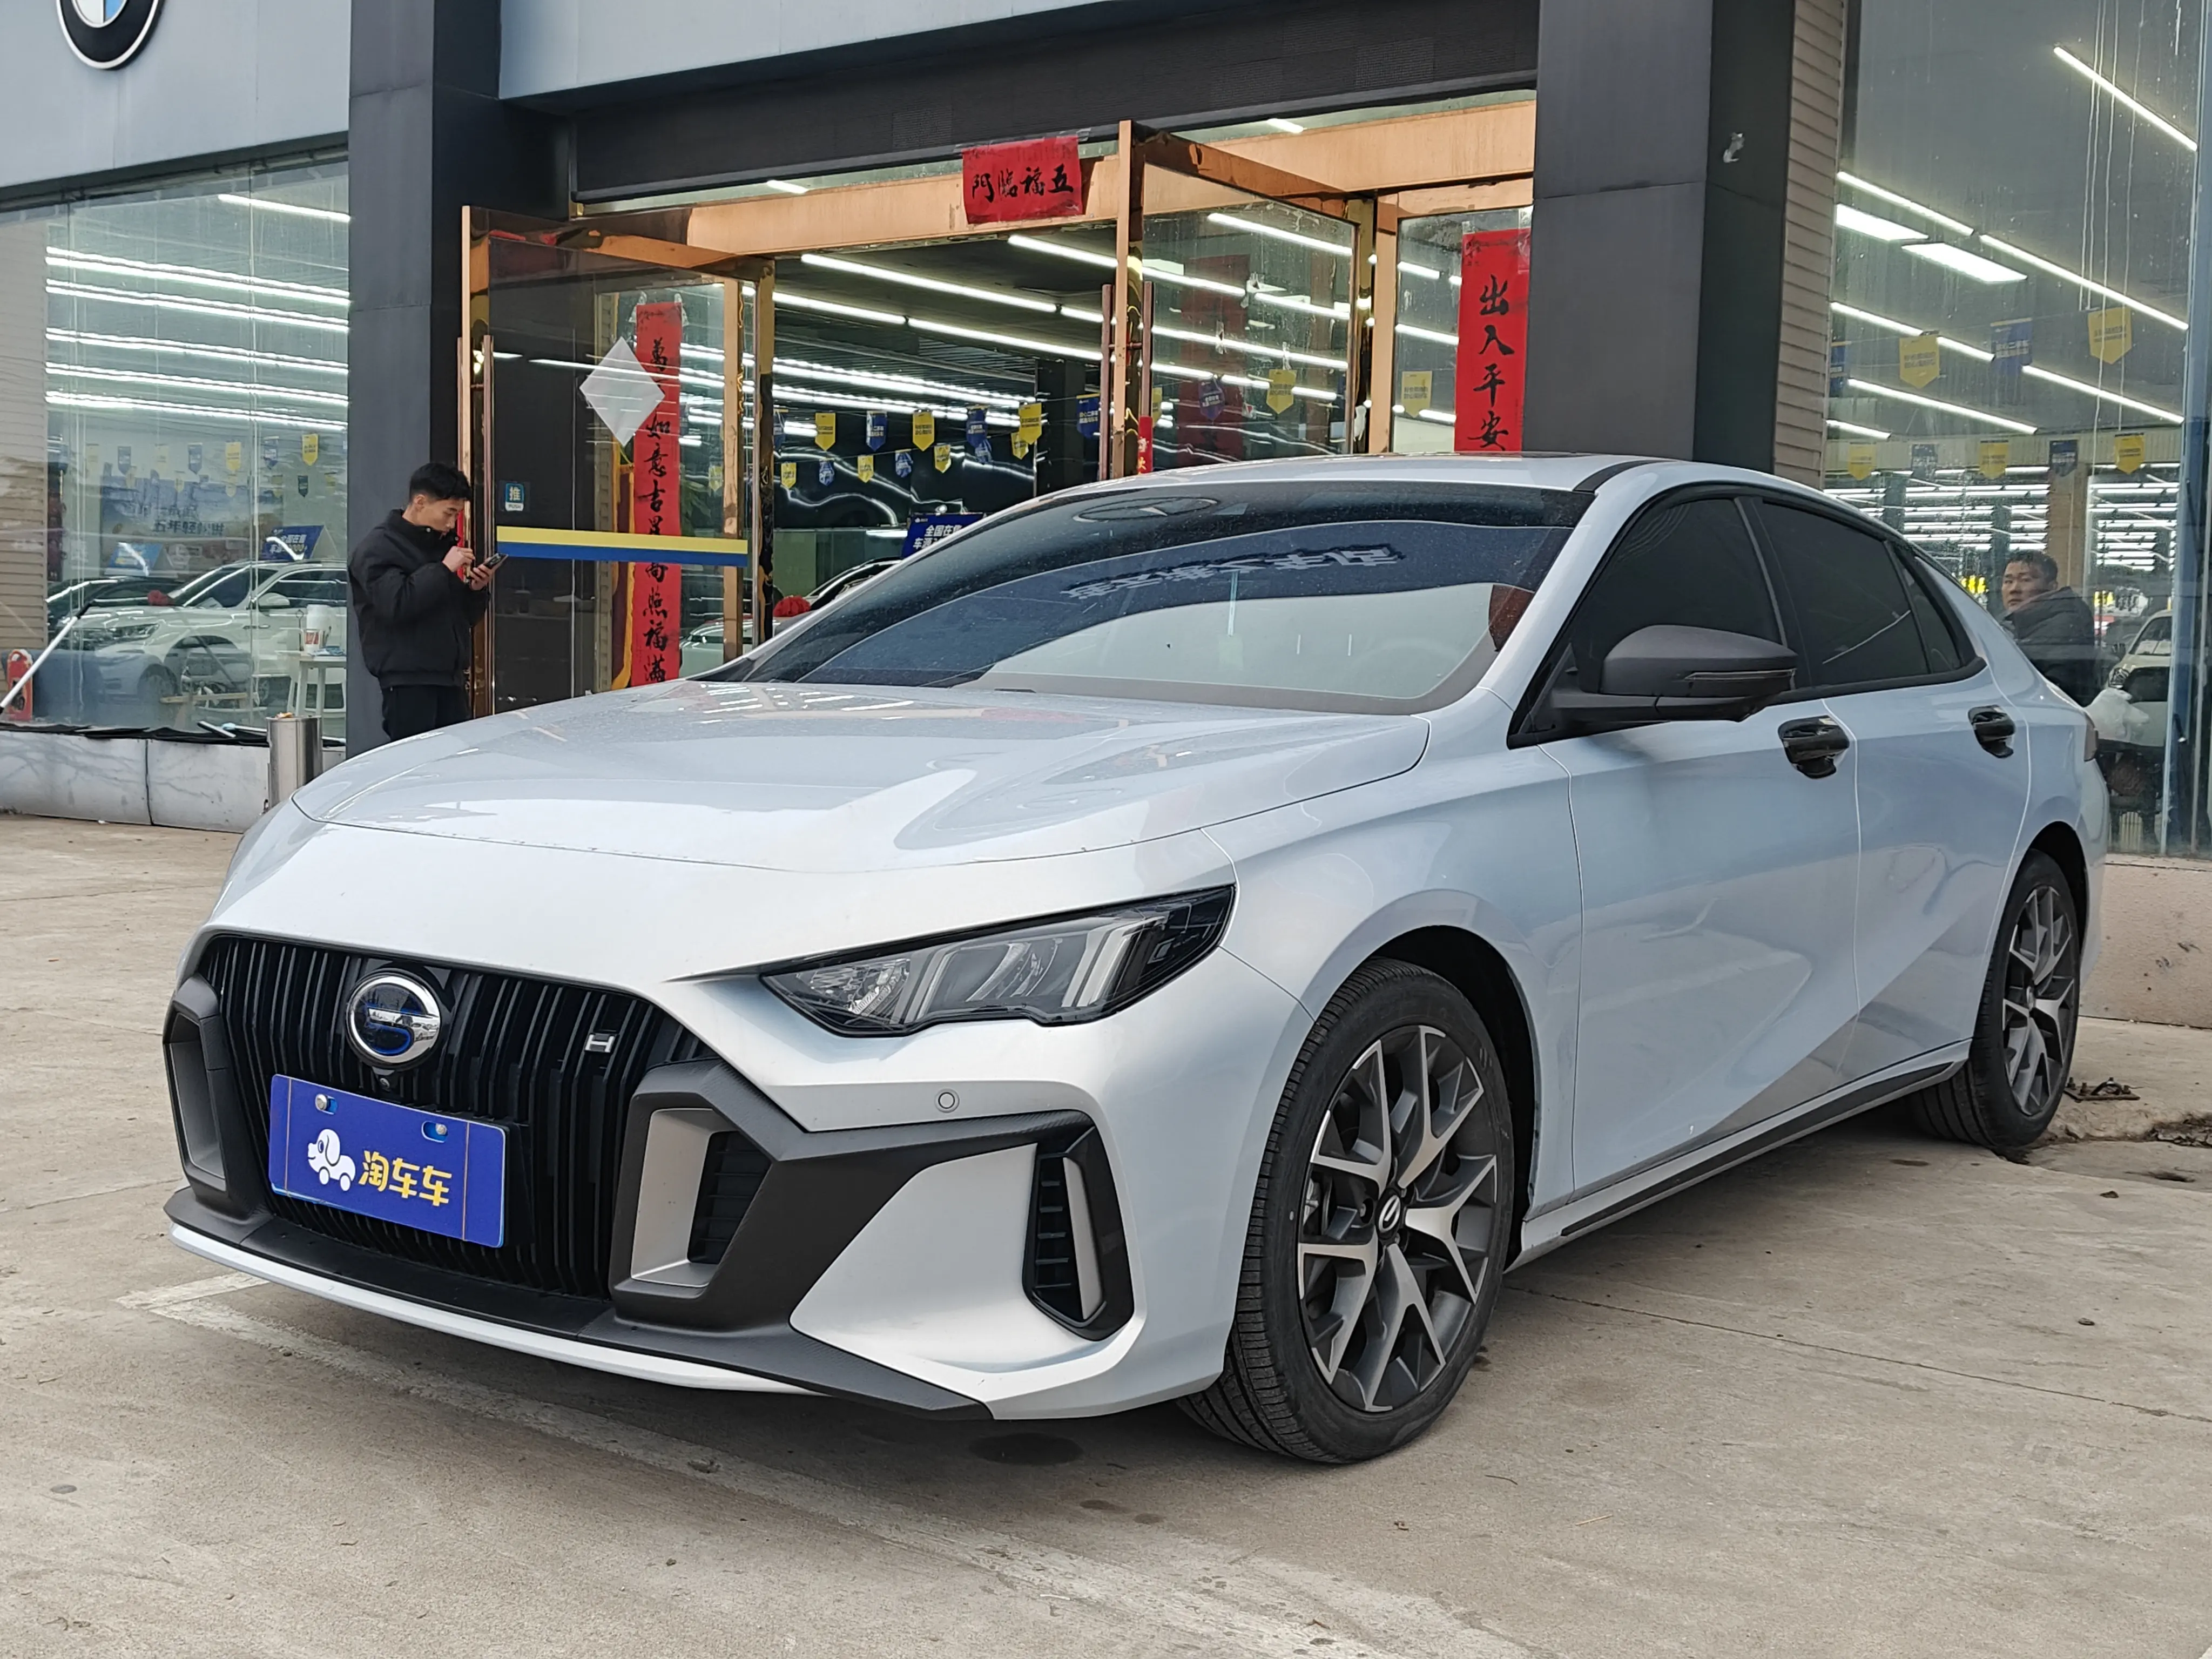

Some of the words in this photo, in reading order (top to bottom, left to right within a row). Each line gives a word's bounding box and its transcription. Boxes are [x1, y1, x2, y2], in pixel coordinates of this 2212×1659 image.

[1467, 274, 1515, 451] 出入平安
[509, 486, 521, 501] 推
[585, 1034, 615, 1053] H
[358, 1150, 453, 1206] 淘车车
